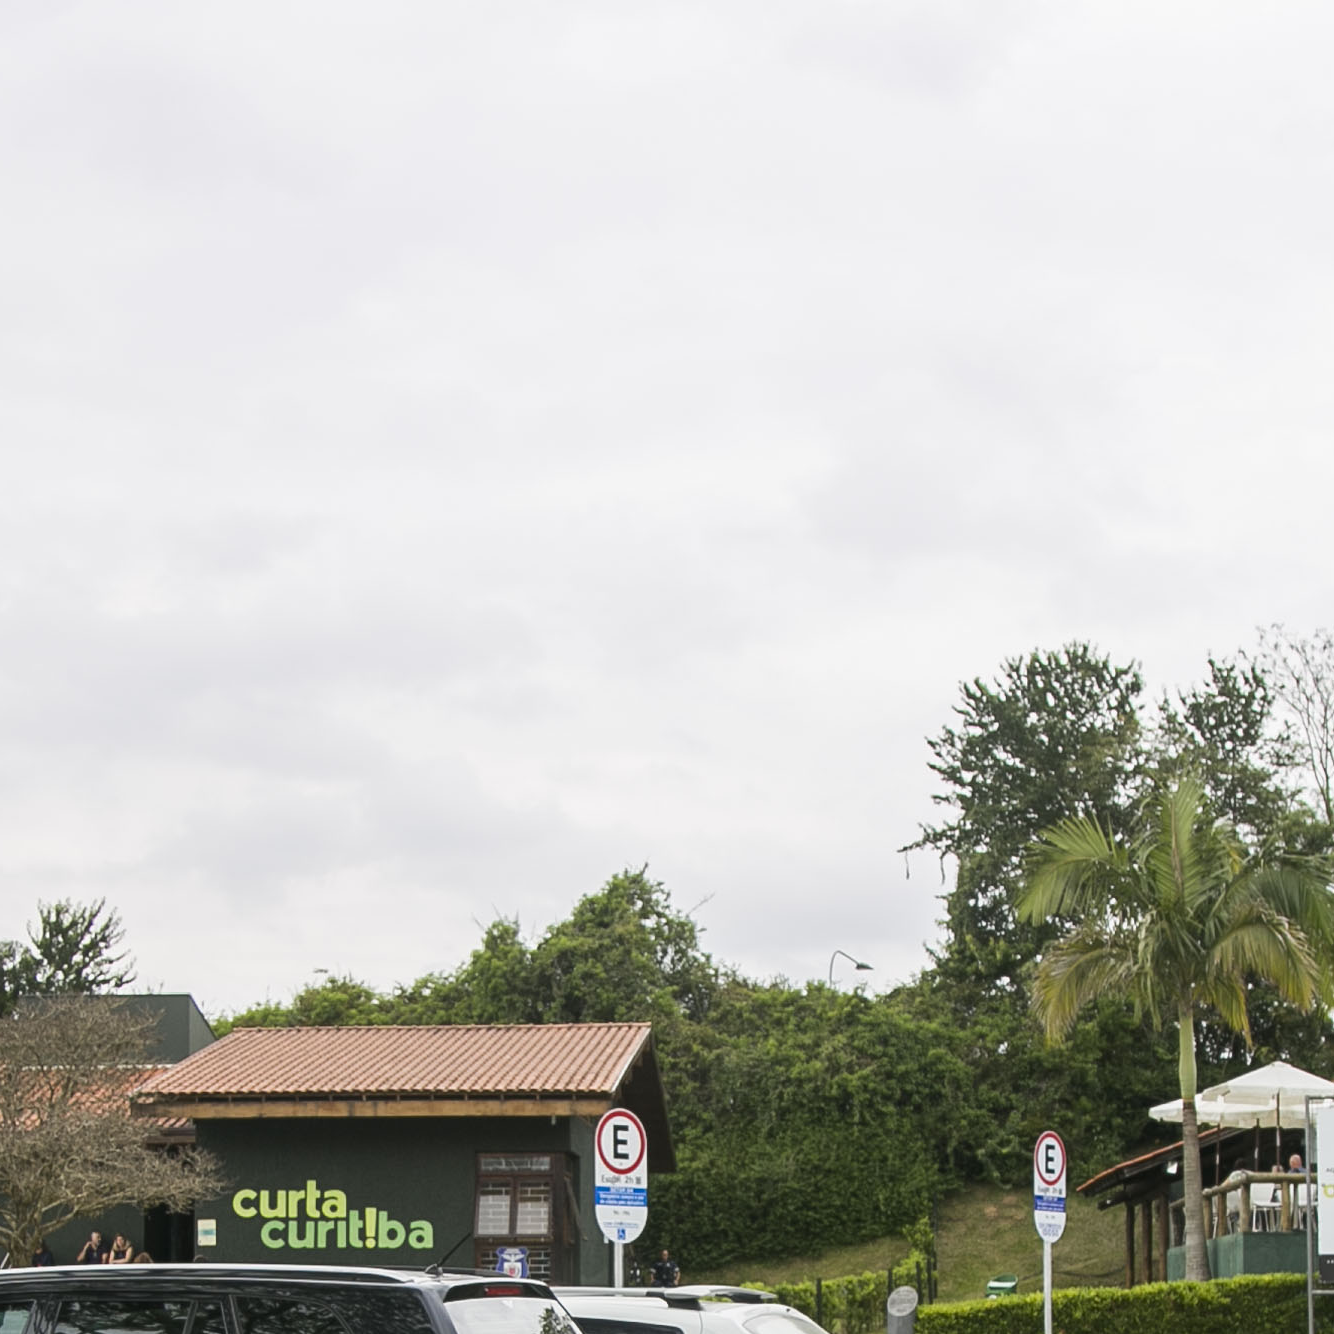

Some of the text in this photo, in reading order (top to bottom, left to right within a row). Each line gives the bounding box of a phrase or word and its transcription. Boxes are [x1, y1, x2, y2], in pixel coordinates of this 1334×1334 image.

[612, 1124, 629, 1160] E
[1045, 1144, 1056, 1174] E
[232, 1180, 347, 1218] curta
